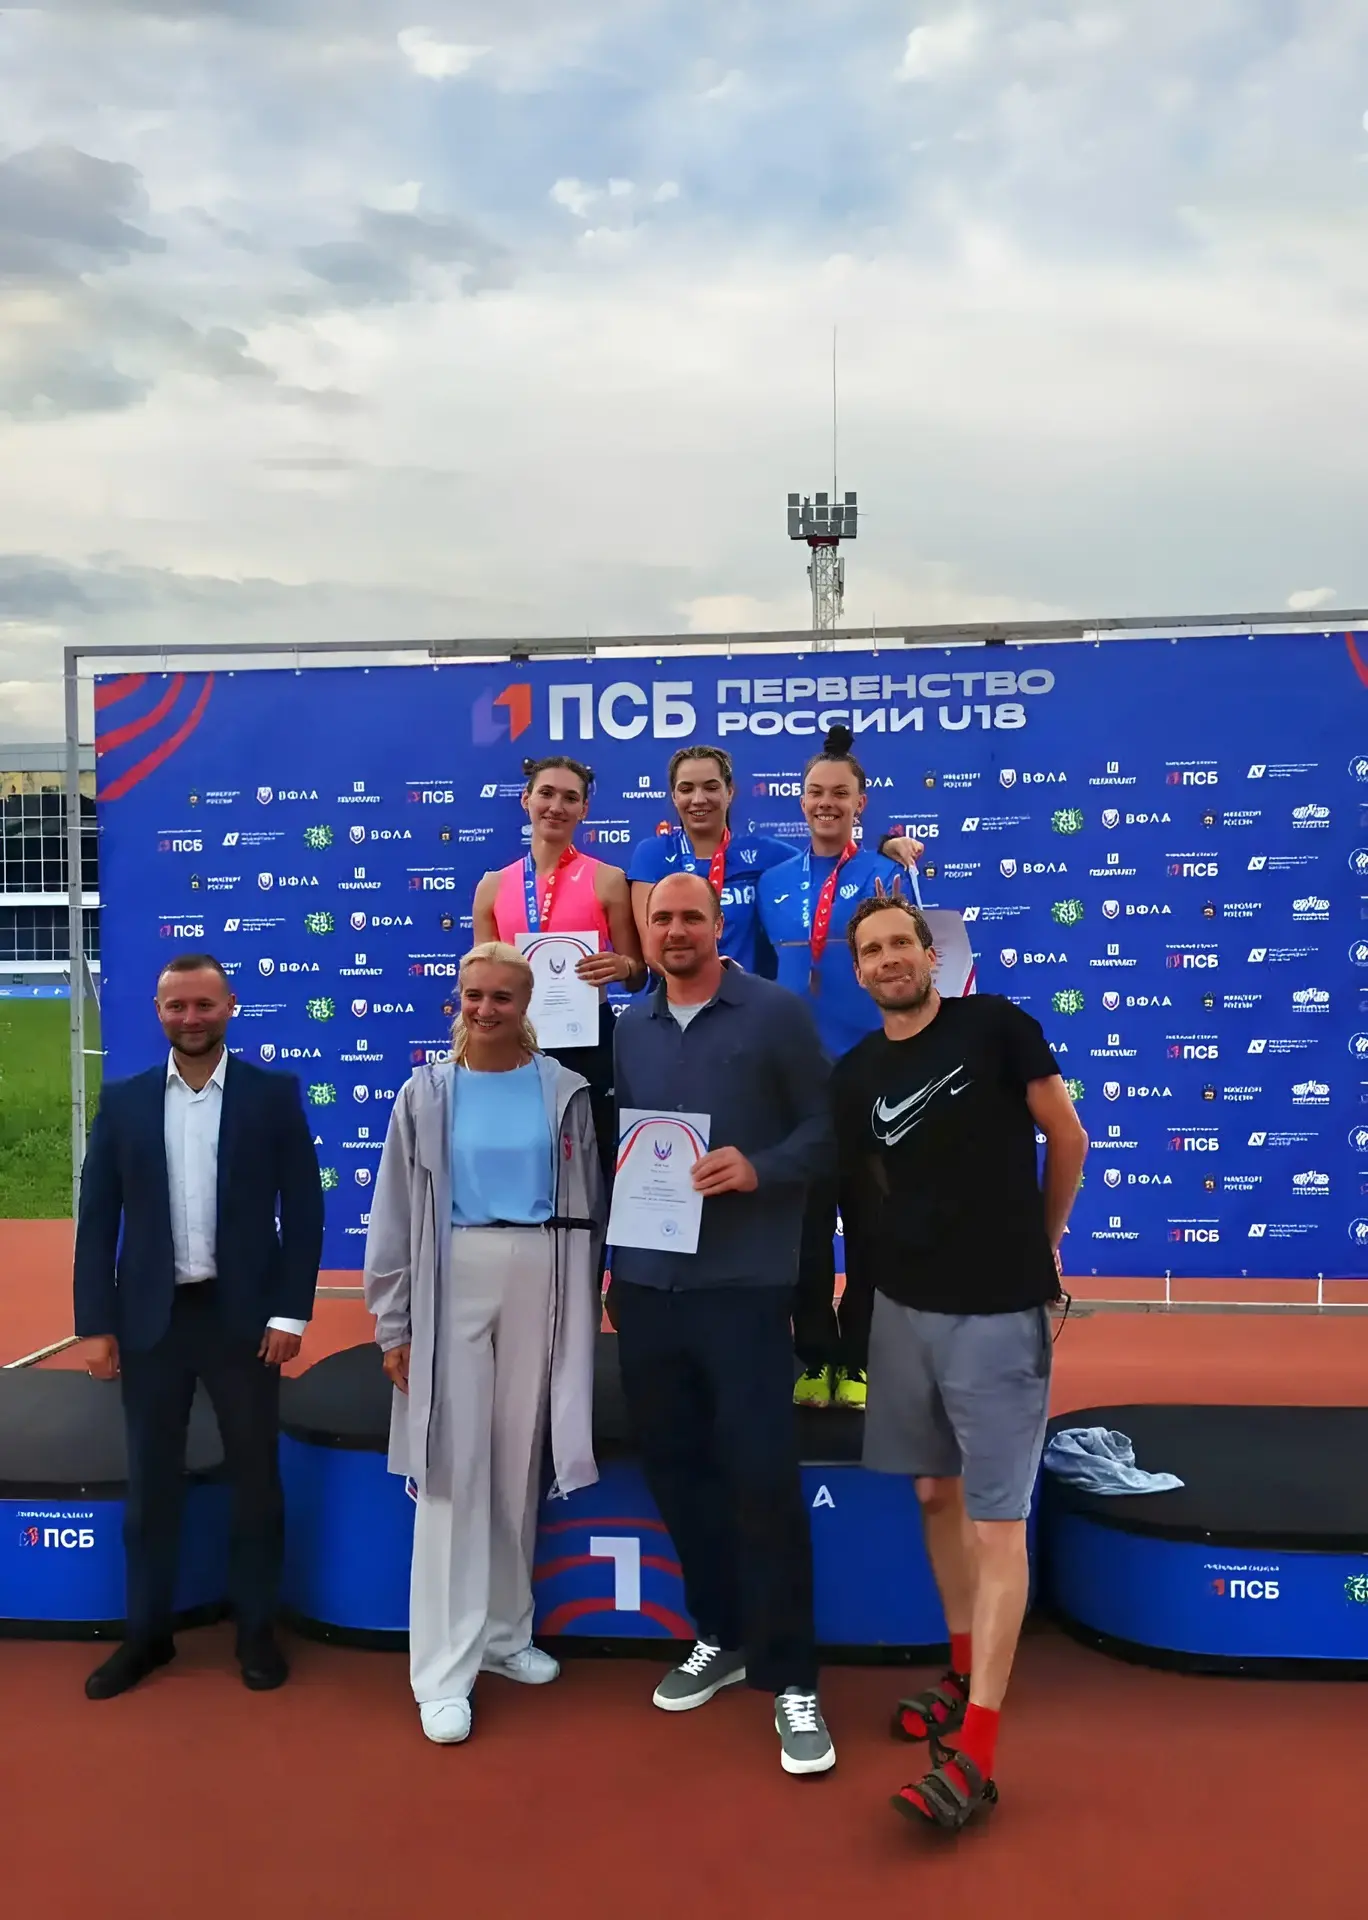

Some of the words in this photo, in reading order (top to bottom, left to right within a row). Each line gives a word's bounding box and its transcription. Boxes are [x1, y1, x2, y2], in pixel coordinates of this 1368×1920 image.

[718, 669, 1055, 704] ПЕРВЕНСТВО
[549, 681, 696, 740] ПСБ
[718, 706, 923, 736] РОССИИ
[939, 703, 1027, 731] U18
[865, 776, 894, 788] ФЛА
[1022, 771, 1067, 784] ВФЛА
[1183, 771, 1218, 785] ПСБ
[423, 791, 454, 803] ПСБ
[769, 783, 803, 798] ПСБ
[1125, 812, 1171, 824] ВФЛА
[904, 824, 939, 839] ПСБ
[173, 839, 202, 852] ПСБ
[1023, 862, 1068, 874] ВФЛА
[1183, 863, 1218, 877] ПСБ
[423, 878, 455, 889] ПСБ
[1125, 904, 1172, 916] ВФЛА
[174, 925, 204, 937] ПСБ
[1023, 952, 1068, 964] ВФЛА
[1184, 954, 1218, 968] ПСБ
[424, 964, 456, 976] ПСБ
[1126, 995, 1172, 1007] ВФЛА
[373, 1003, 414, 1014] ВФЛА
[1048, 1042, 1069, 1053] ЛА
[1184, 1046, 1218, 1059] ПСБ
[374, 1089, 395, 1100] ВФ
[1127, 1086, 1173, 1097] ВФЛА
[1184, 1138, 1219, 1151] ПСБ
[1127, 1173, 1173, 1185] ВФЛА
[1185, 1229, 1219, 1242] ПСБ
[44, 1529, 94, 1548] ПСБ
[589, 1536, 641, 1611] 1
[1231, 1580, 1279, 1599] ПСБ
